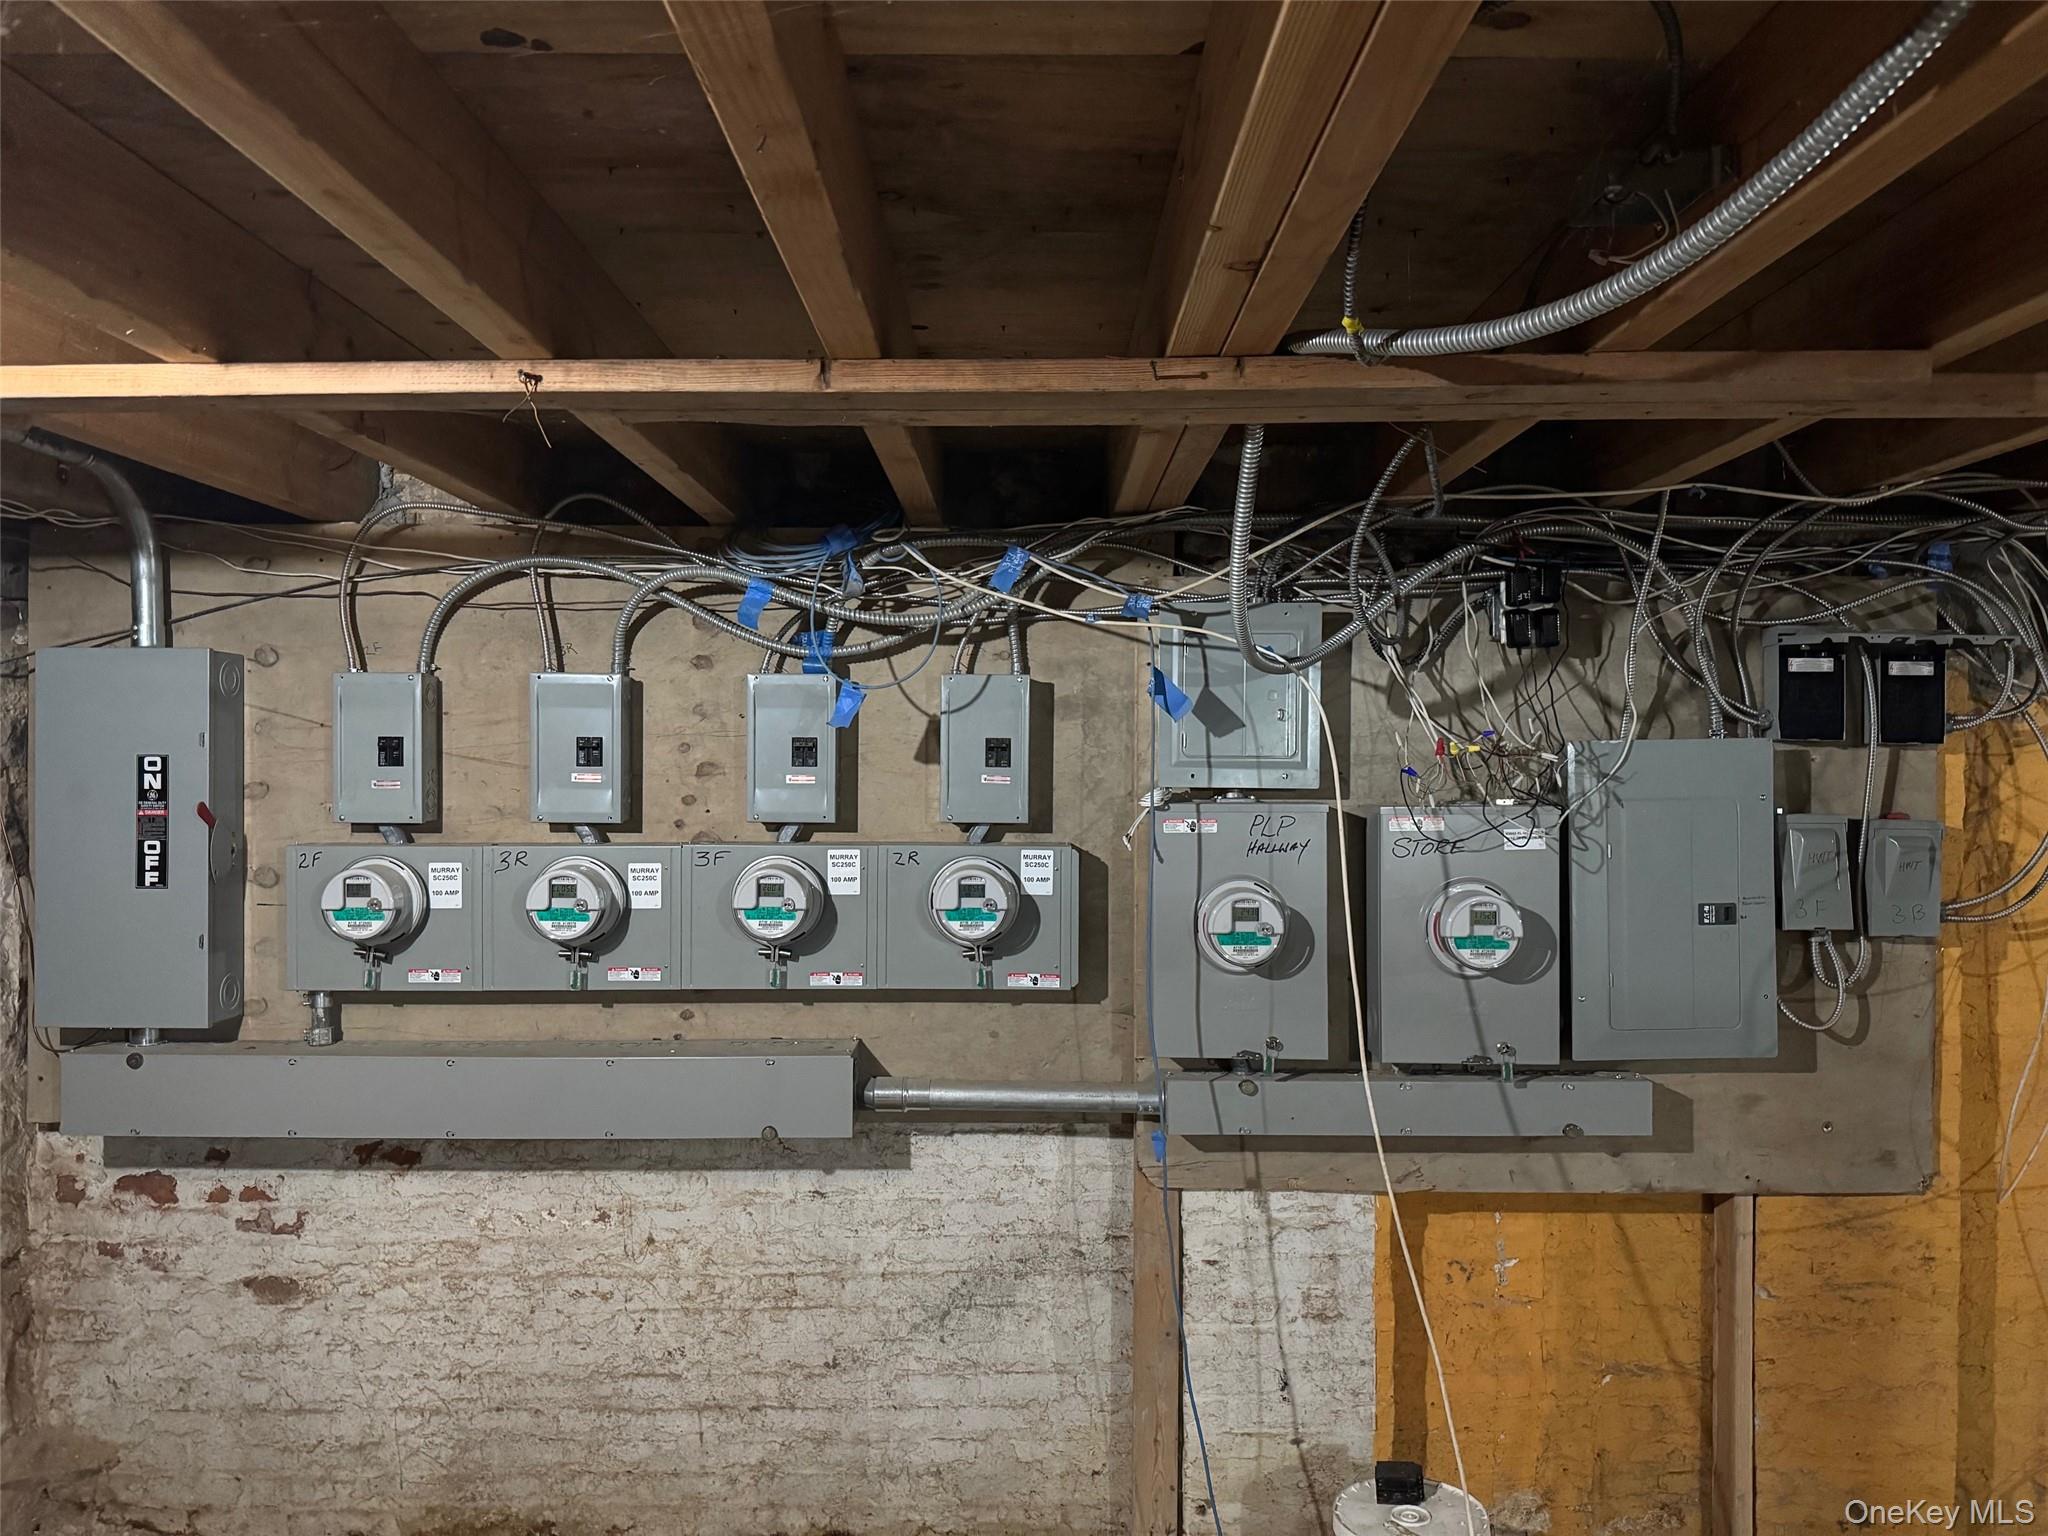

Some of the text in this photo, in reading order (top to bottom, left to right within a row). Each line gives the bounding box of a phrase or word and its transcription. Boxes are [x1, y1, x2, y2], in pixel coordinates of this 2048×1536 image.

[143, 756, 162, 790] ON
[1249, 814, 1296, 837] PLP
[694, 850, 732, 867] 3F
[1392, 837, 1465, 858] STORE
[143, 840, 161, 887] OFF
[298, 851, 323, 869] 2F
[494, 850, 529, 874] 3R
